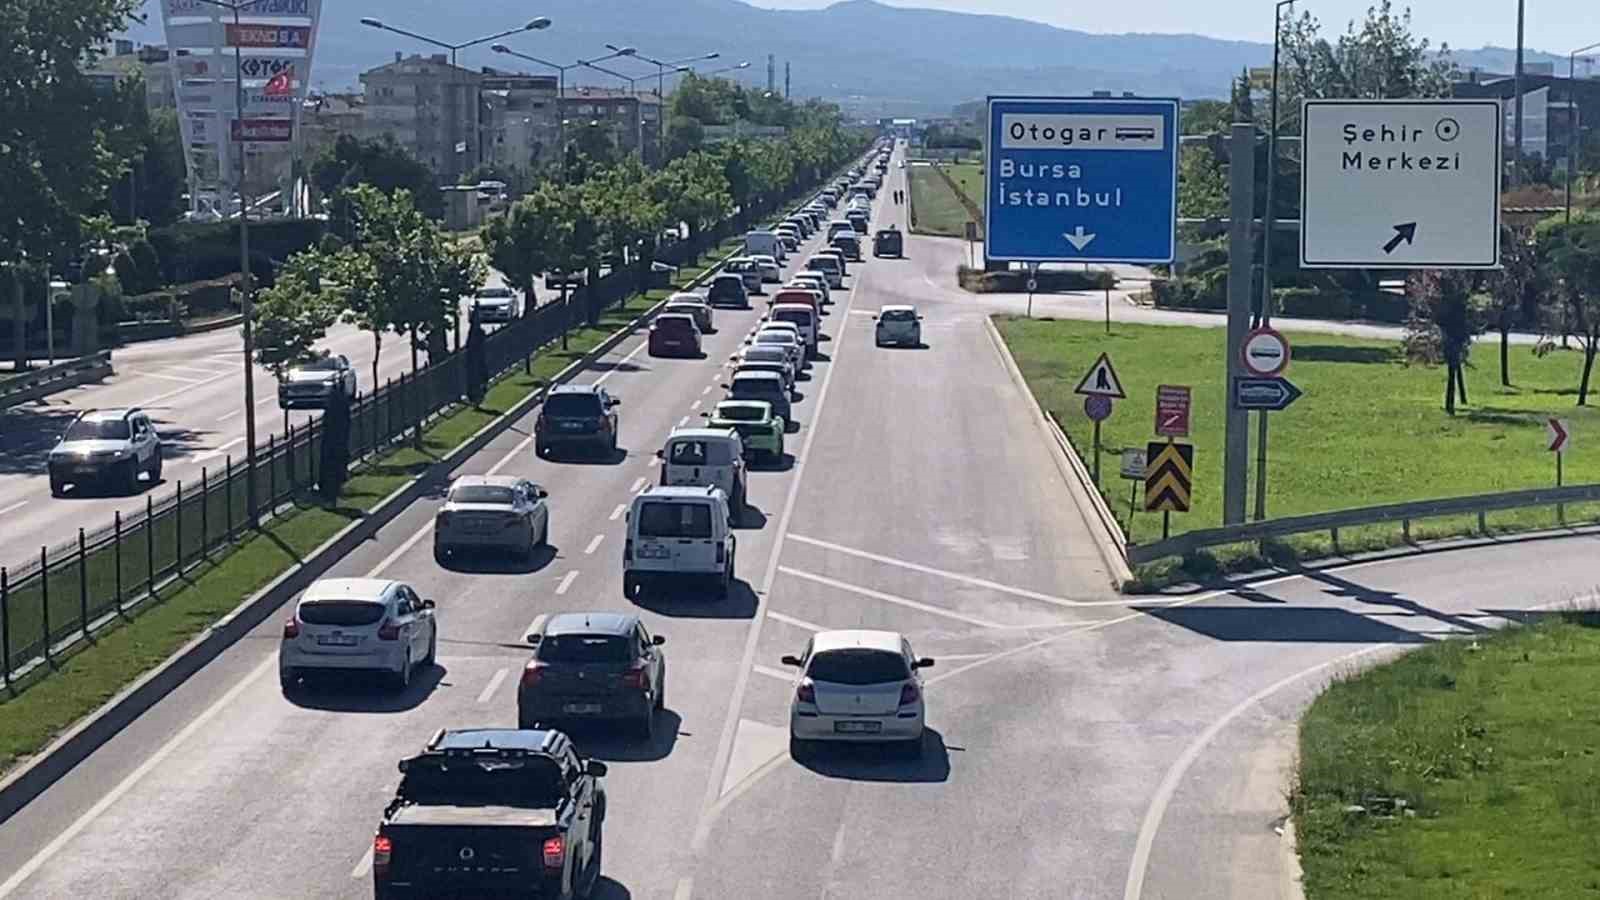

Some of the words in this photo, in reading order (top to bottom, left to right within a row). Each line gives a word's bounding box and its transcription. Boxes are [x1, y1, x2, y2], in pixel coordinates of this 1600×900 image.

[1010, 122, 1107, 145] Otogar
[1343, 123, 1423, 145] Şehir
[1000, 159, 1081, 179] Bursa
[1342, 151, 1460, 170] Merkezi
[1000, 183, 1121, 206] İstanbul
